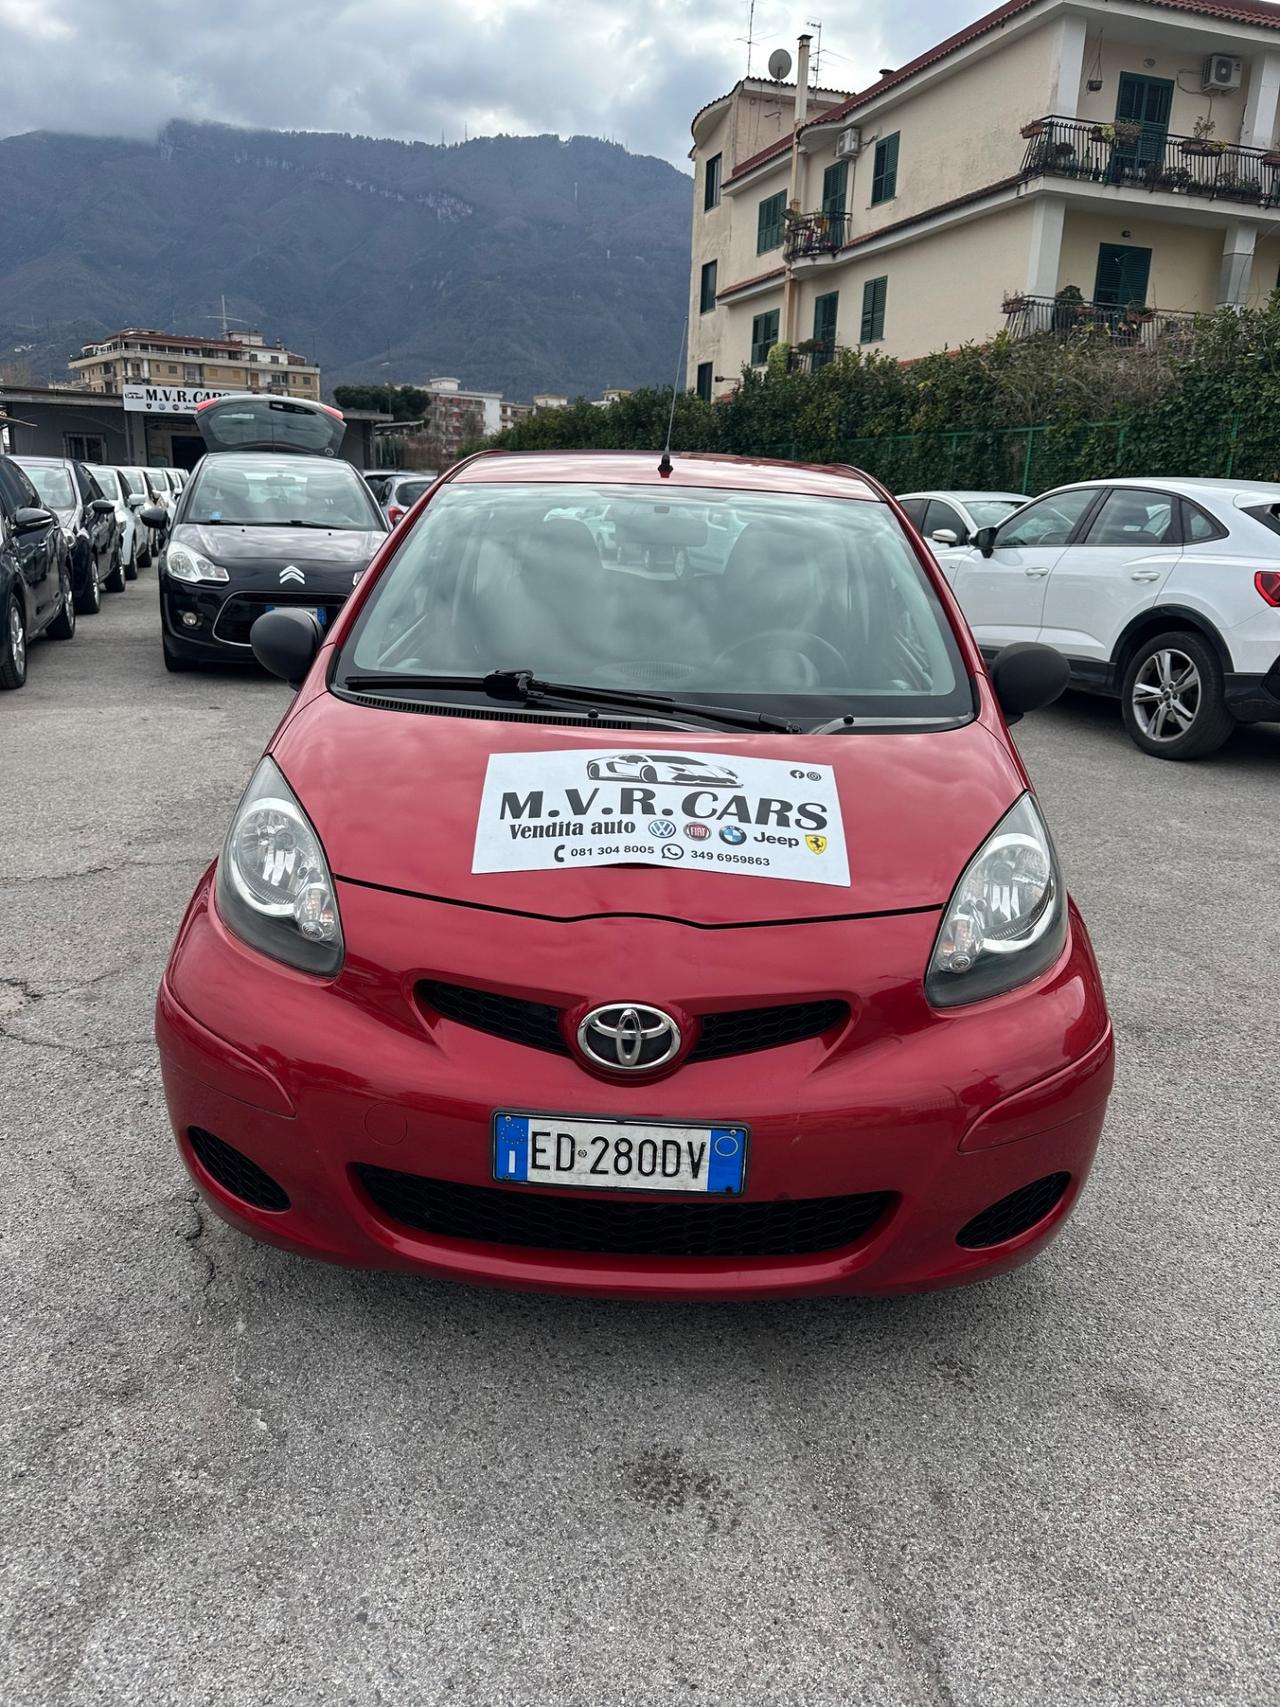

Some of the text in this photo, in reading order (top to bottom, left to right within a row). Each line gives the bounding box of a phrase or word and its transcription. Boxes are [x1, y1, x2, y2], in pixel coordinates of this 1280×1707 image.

[509, 820, 636, 840] Vendita auto
[689, 826, 706, 837] FIAT
[753, 832, 800, 848] Jeep
[570, 845, 655, 857] 081 304 8005
[690, 850, 770, 866] 349 6959863
